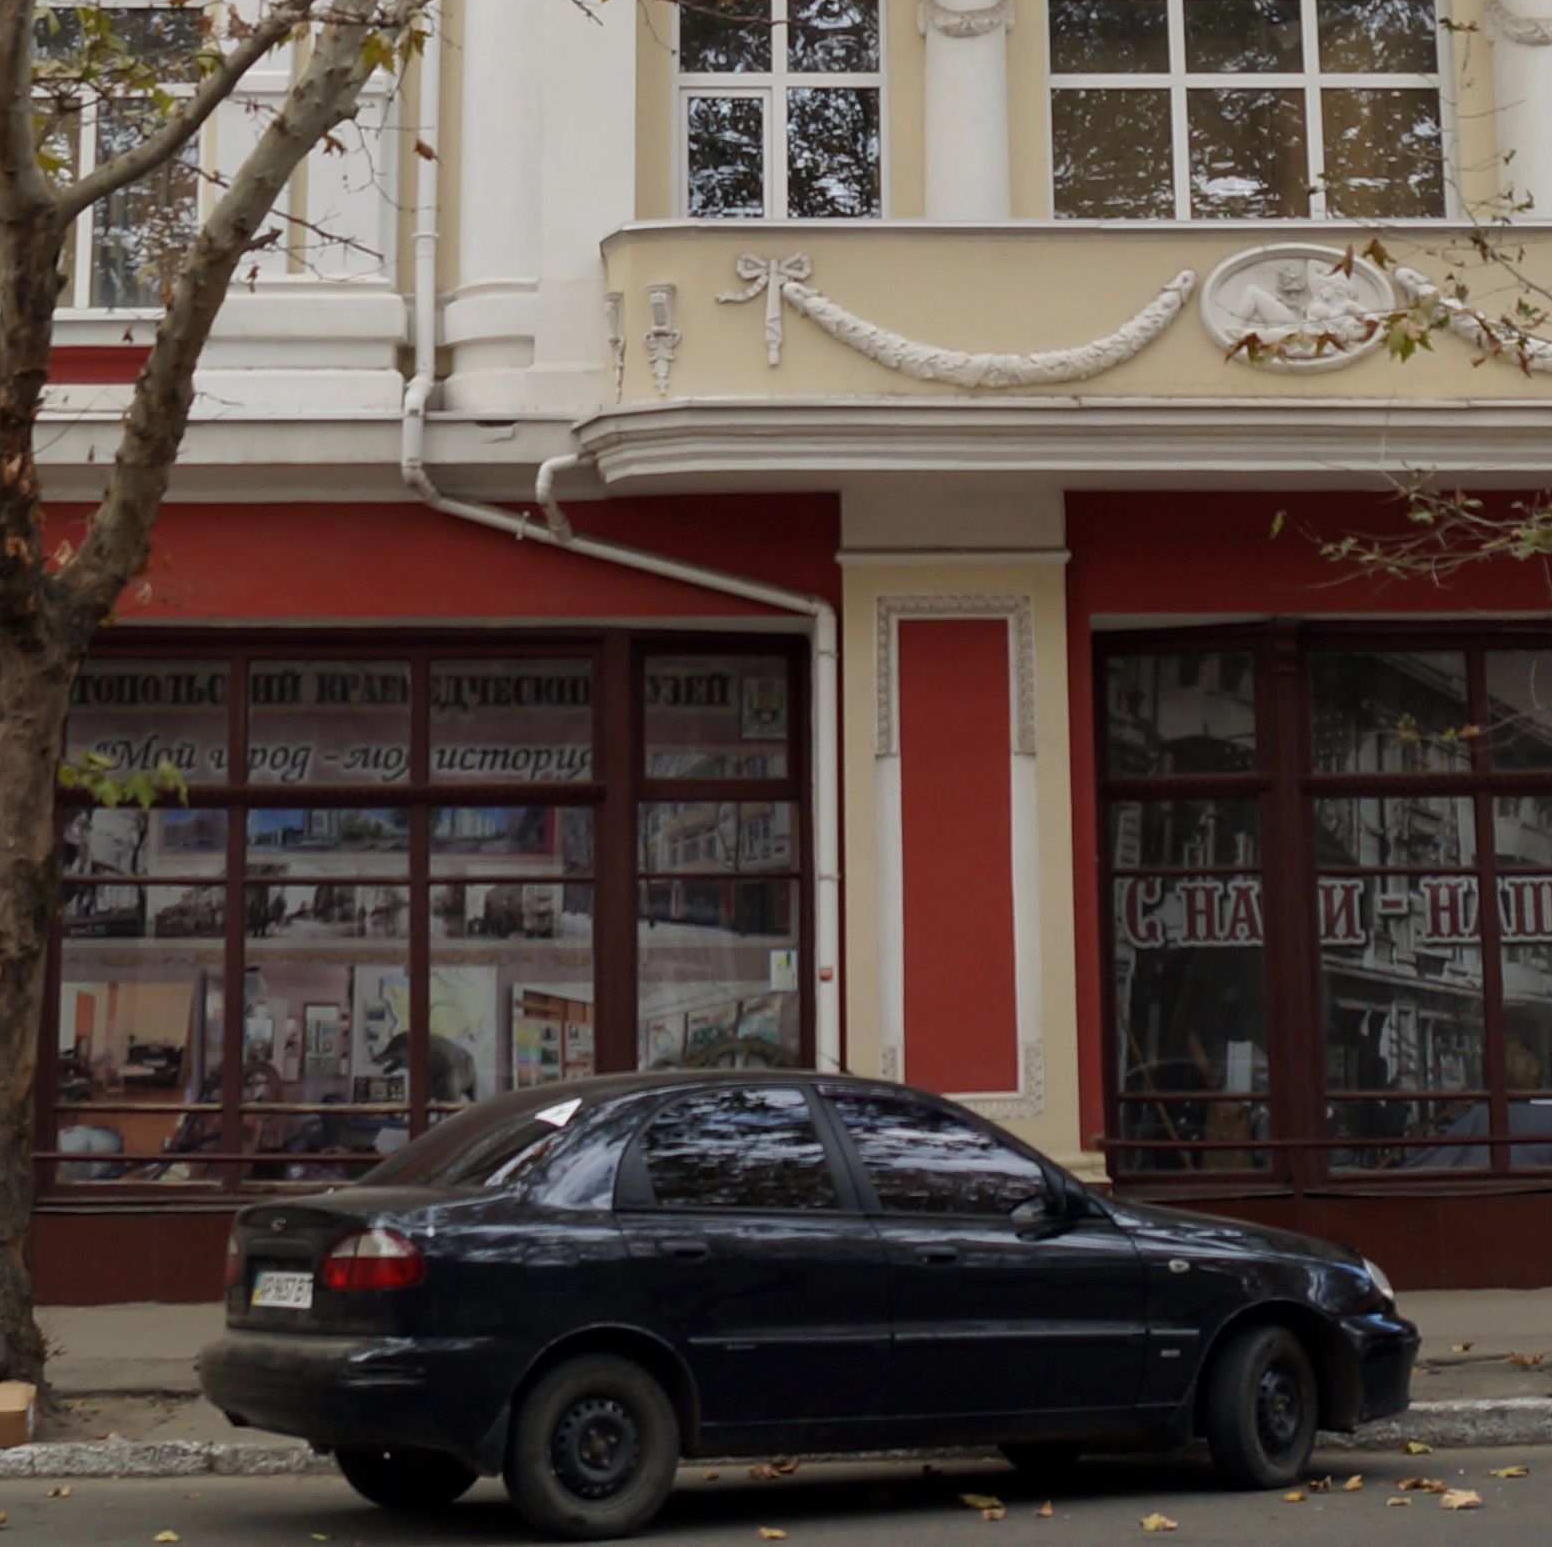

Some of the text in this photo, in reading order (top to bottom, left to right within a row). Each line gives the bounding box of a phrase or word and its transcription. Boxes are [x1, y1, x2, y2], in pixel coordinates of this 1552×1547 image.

[71, 672, 302, 705] ТОПОЛЬСИЙ
[645, 671, 730, 706] УЗЕЙ
[209, 745, 313, 784] грод
[1176, 878, 1369, 948] НАИ
